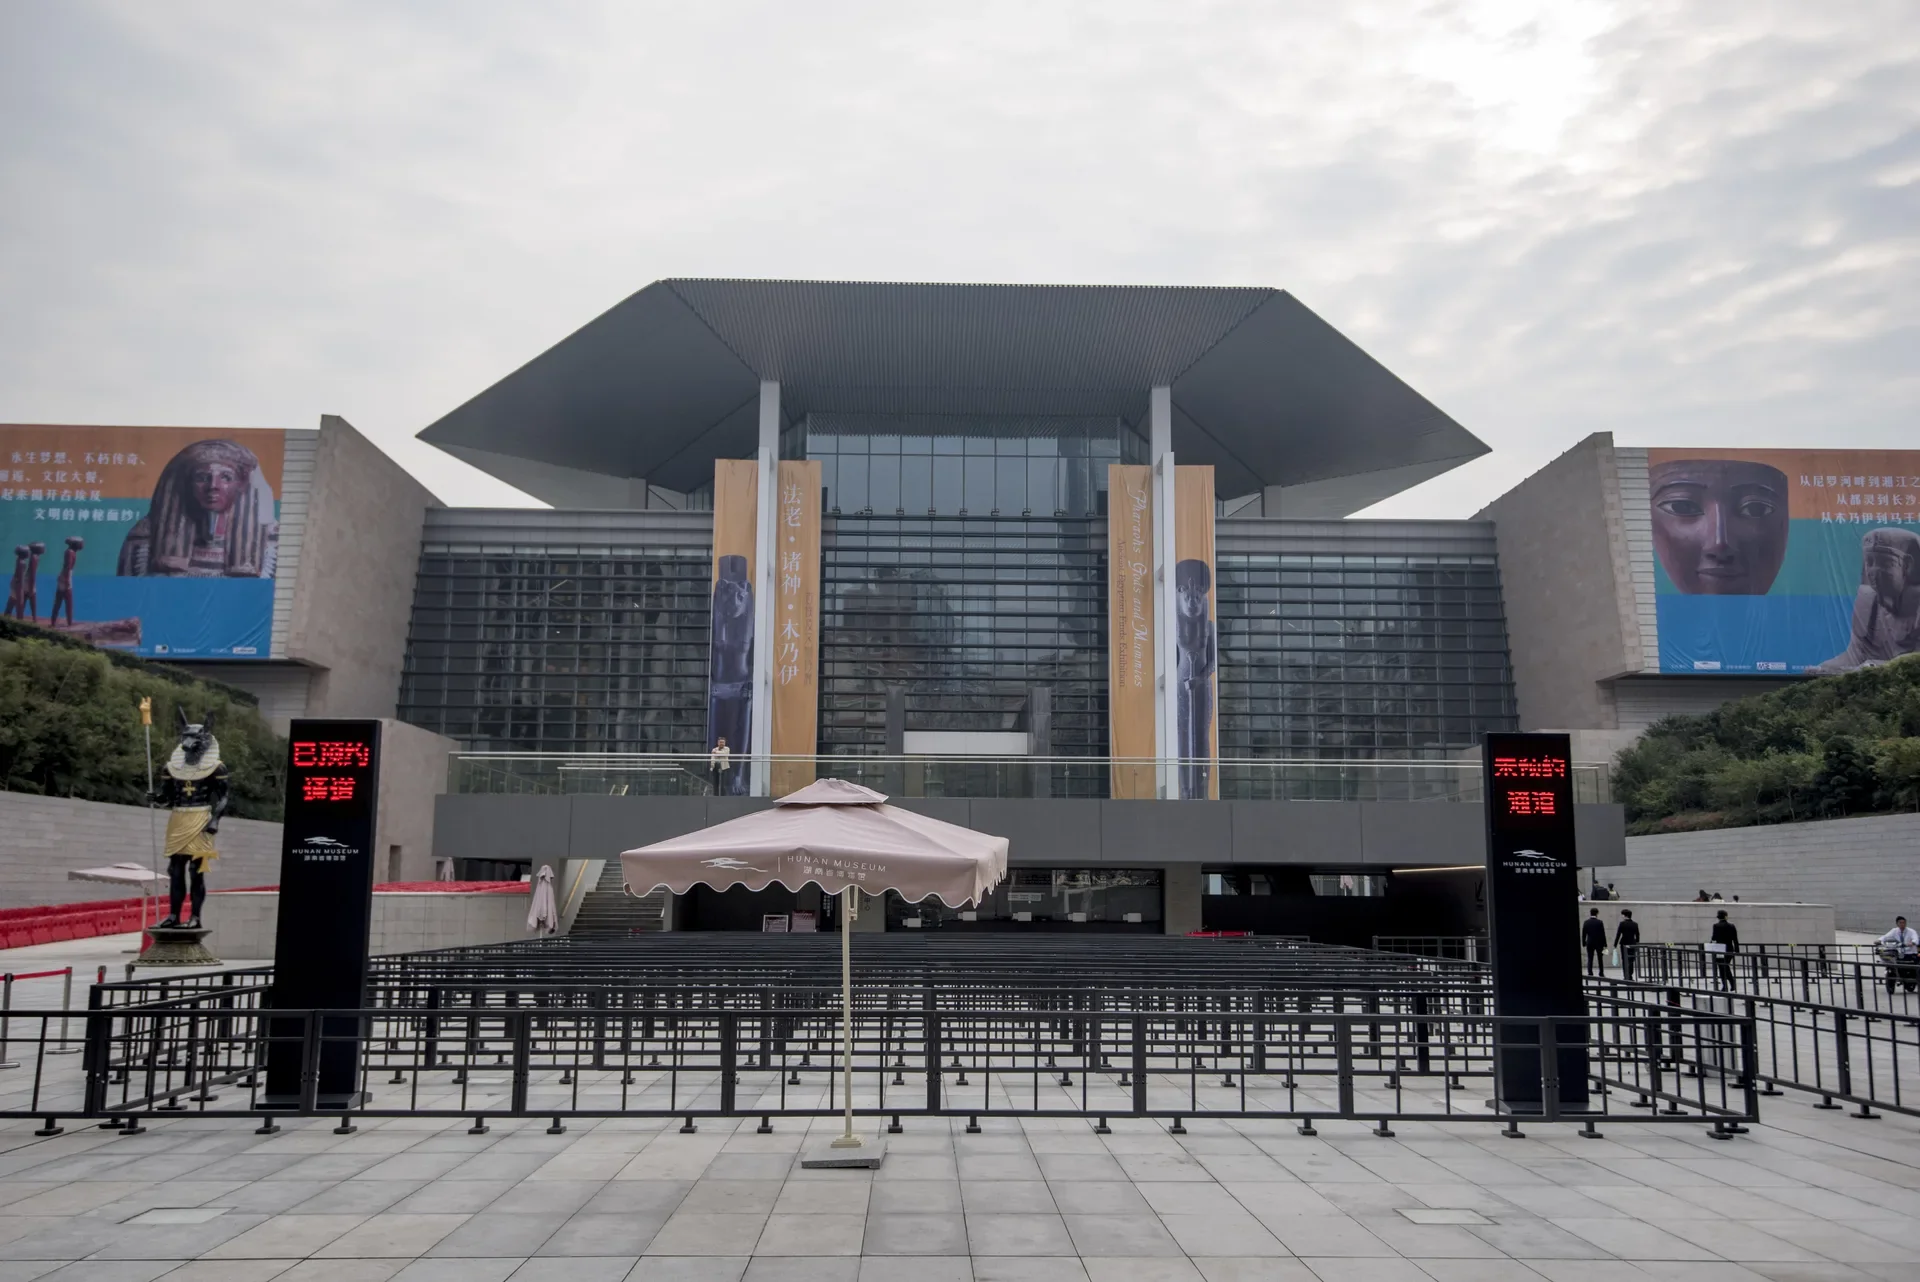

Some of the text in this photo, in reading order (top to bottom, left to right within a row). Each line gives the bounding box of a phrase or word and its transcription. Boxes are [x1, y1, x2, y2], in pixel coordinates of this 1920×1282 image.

[1837, 493, 1920, 506] 从都灵到长沙
[1128, 488, 1149, 688] Pharaohs Gods and Mummies
[1119, 642, 1127, 687] Exhibition
[1507, 791, 1556, 814] 通道
[787, 855, 886, 872] HUNAN MUSEUM
